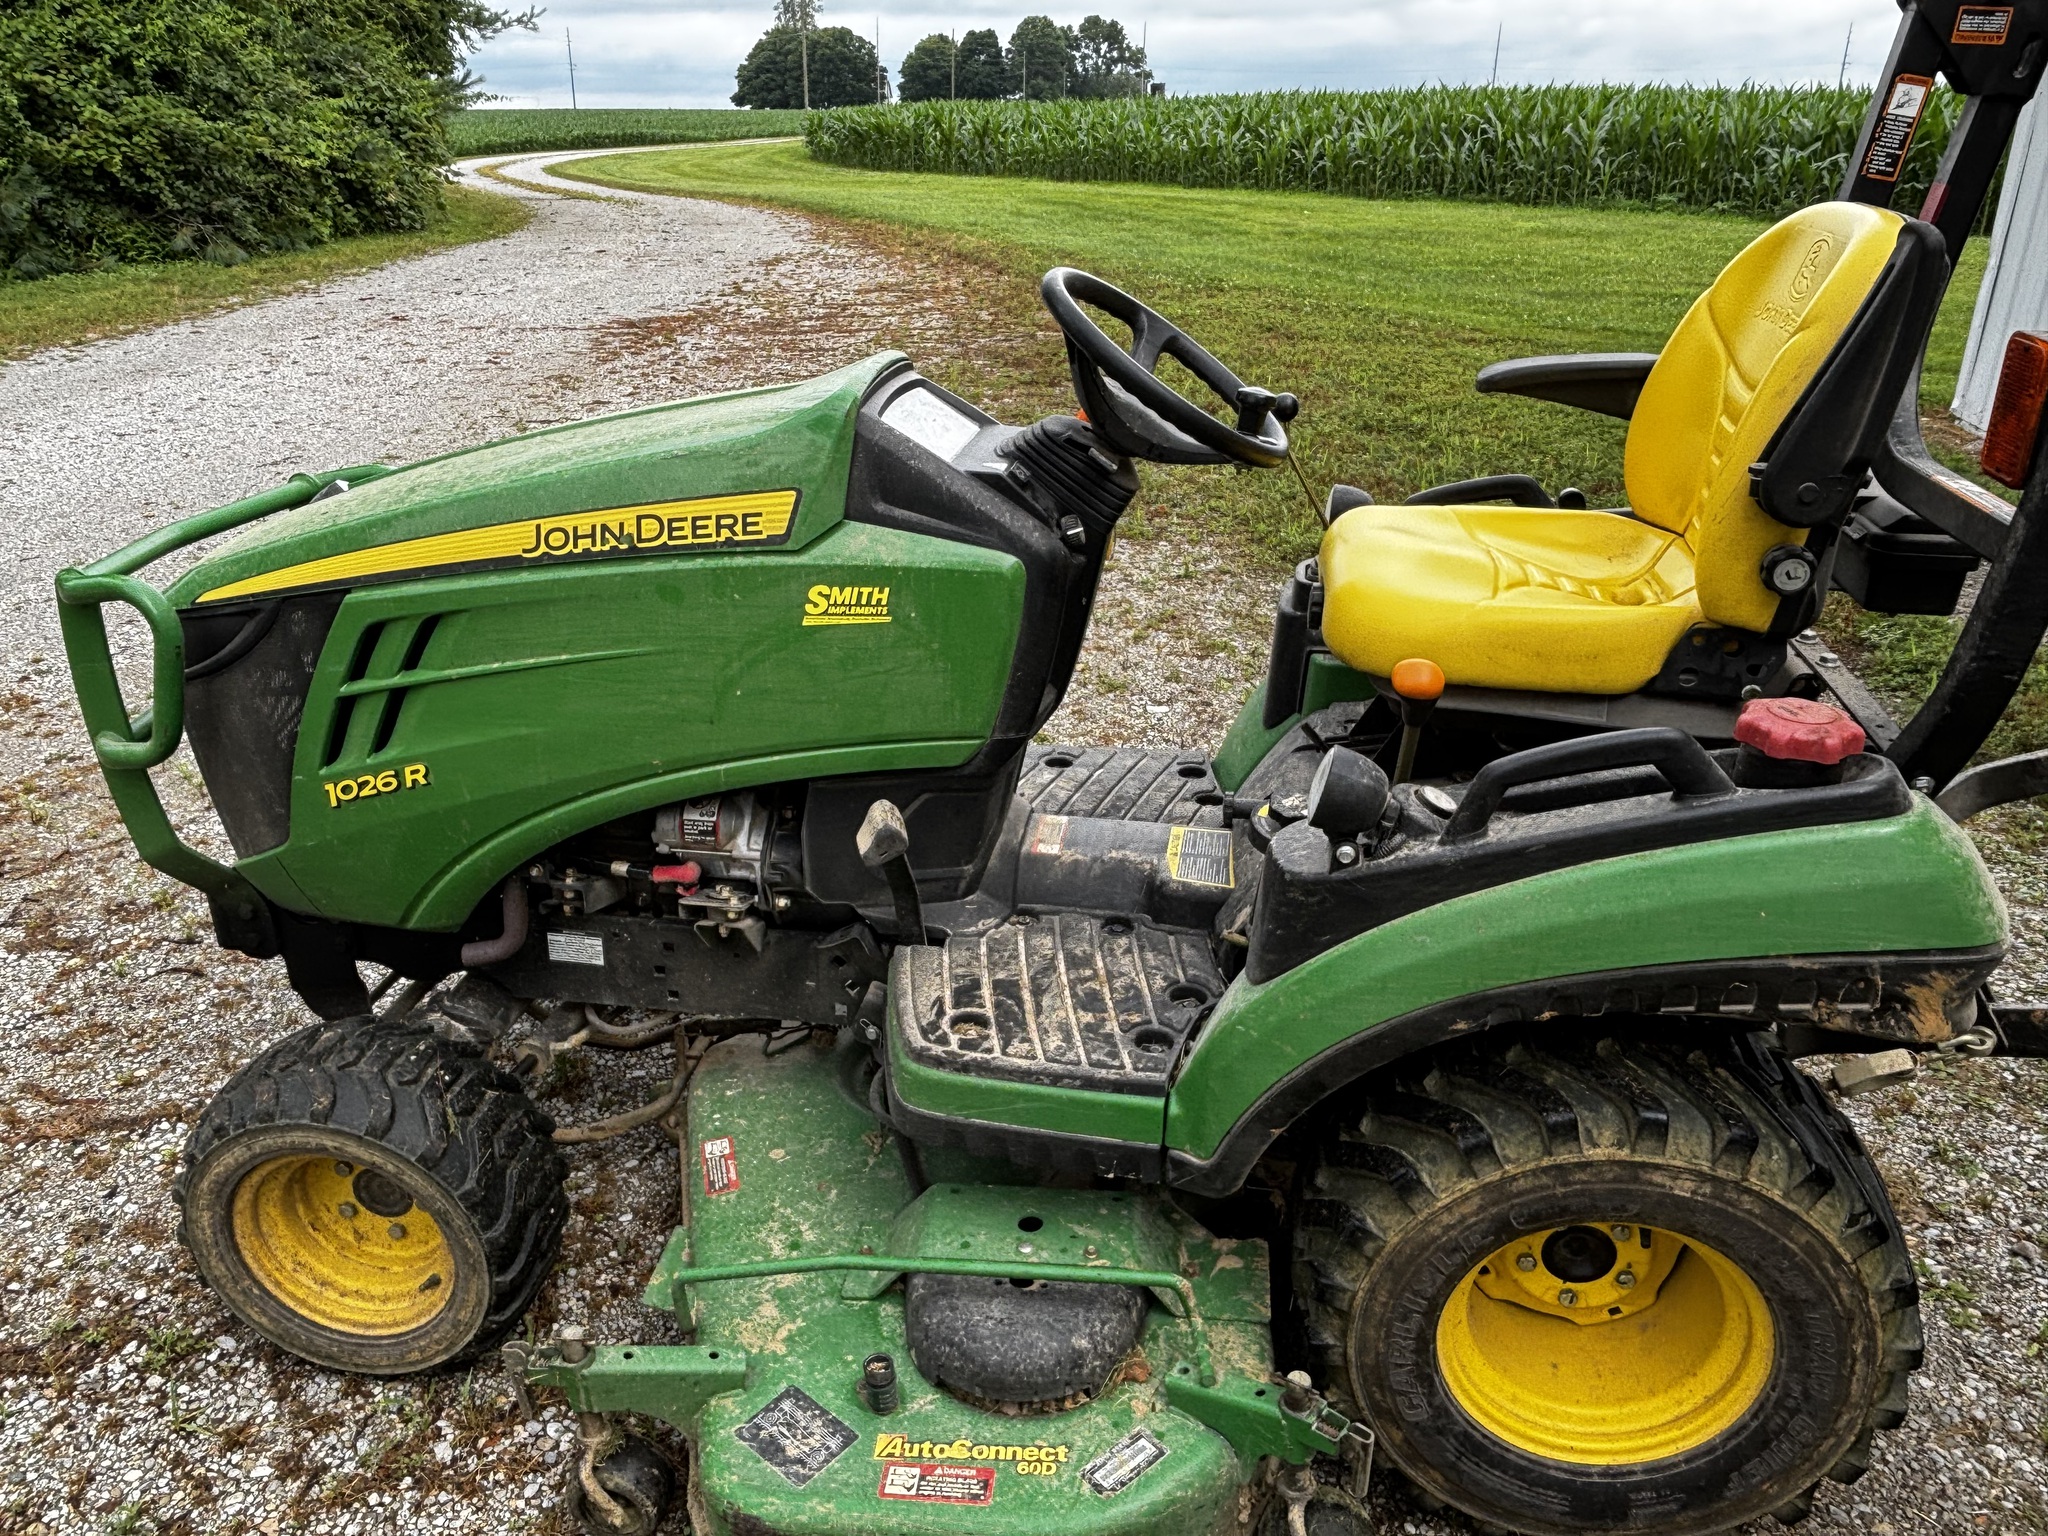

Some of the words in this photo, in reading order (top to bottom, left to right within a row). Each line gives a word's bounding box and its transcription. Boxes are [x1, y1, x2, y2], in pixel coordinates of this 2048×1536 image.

[521, 521, 625, 555] JOHN
[635, 511, 764, 547] DEERE
[804, 584, 890, 615] SMITH
[827, 606, 889, 615] IMPLEMENTS
[324, 770, 398, 808] 1026
[404, 763, 428, 789] R
[877, 1436, 1069, 1463] AutoConnect
[1016, 1461, 1057, 1476] 60D
